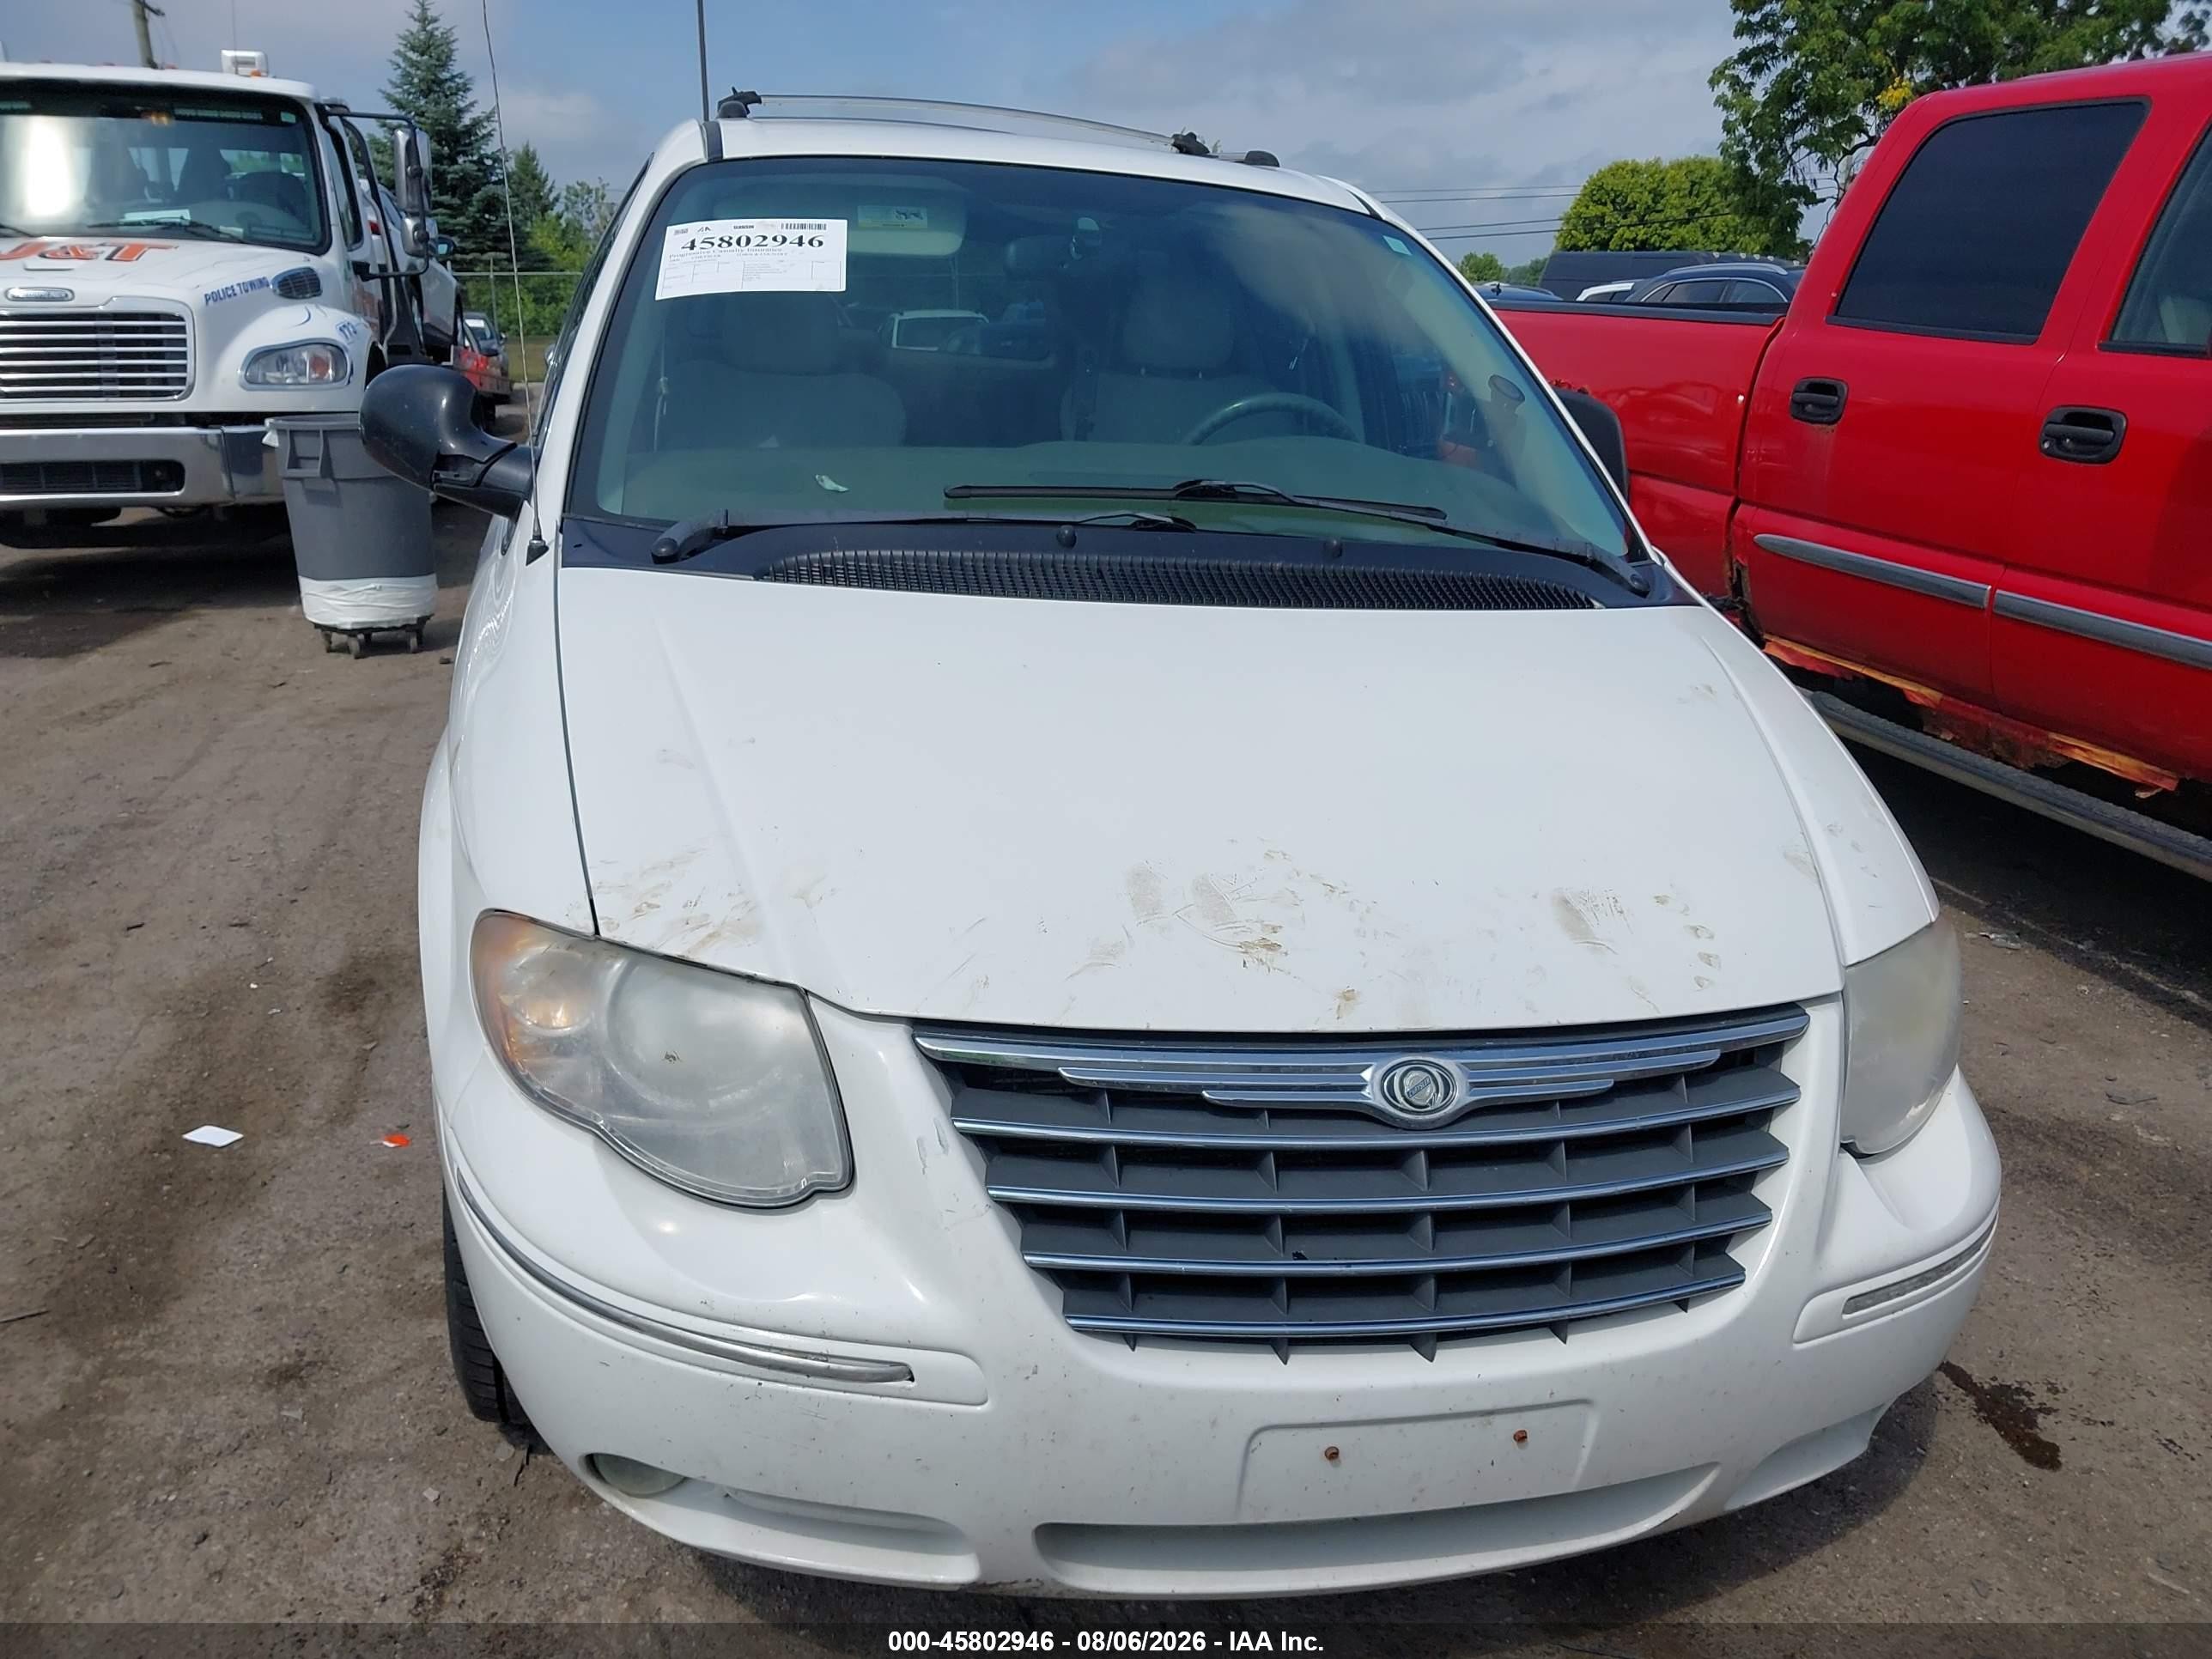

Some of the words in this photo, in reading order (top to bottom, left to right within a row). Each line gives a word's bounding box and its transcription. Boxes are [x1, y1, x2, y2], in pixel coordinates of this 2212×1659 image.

[681, 234, 823, 251] 45802946
[204, 285, 237, 307] POLICE
[236, 276, 270, 295] TOWING
